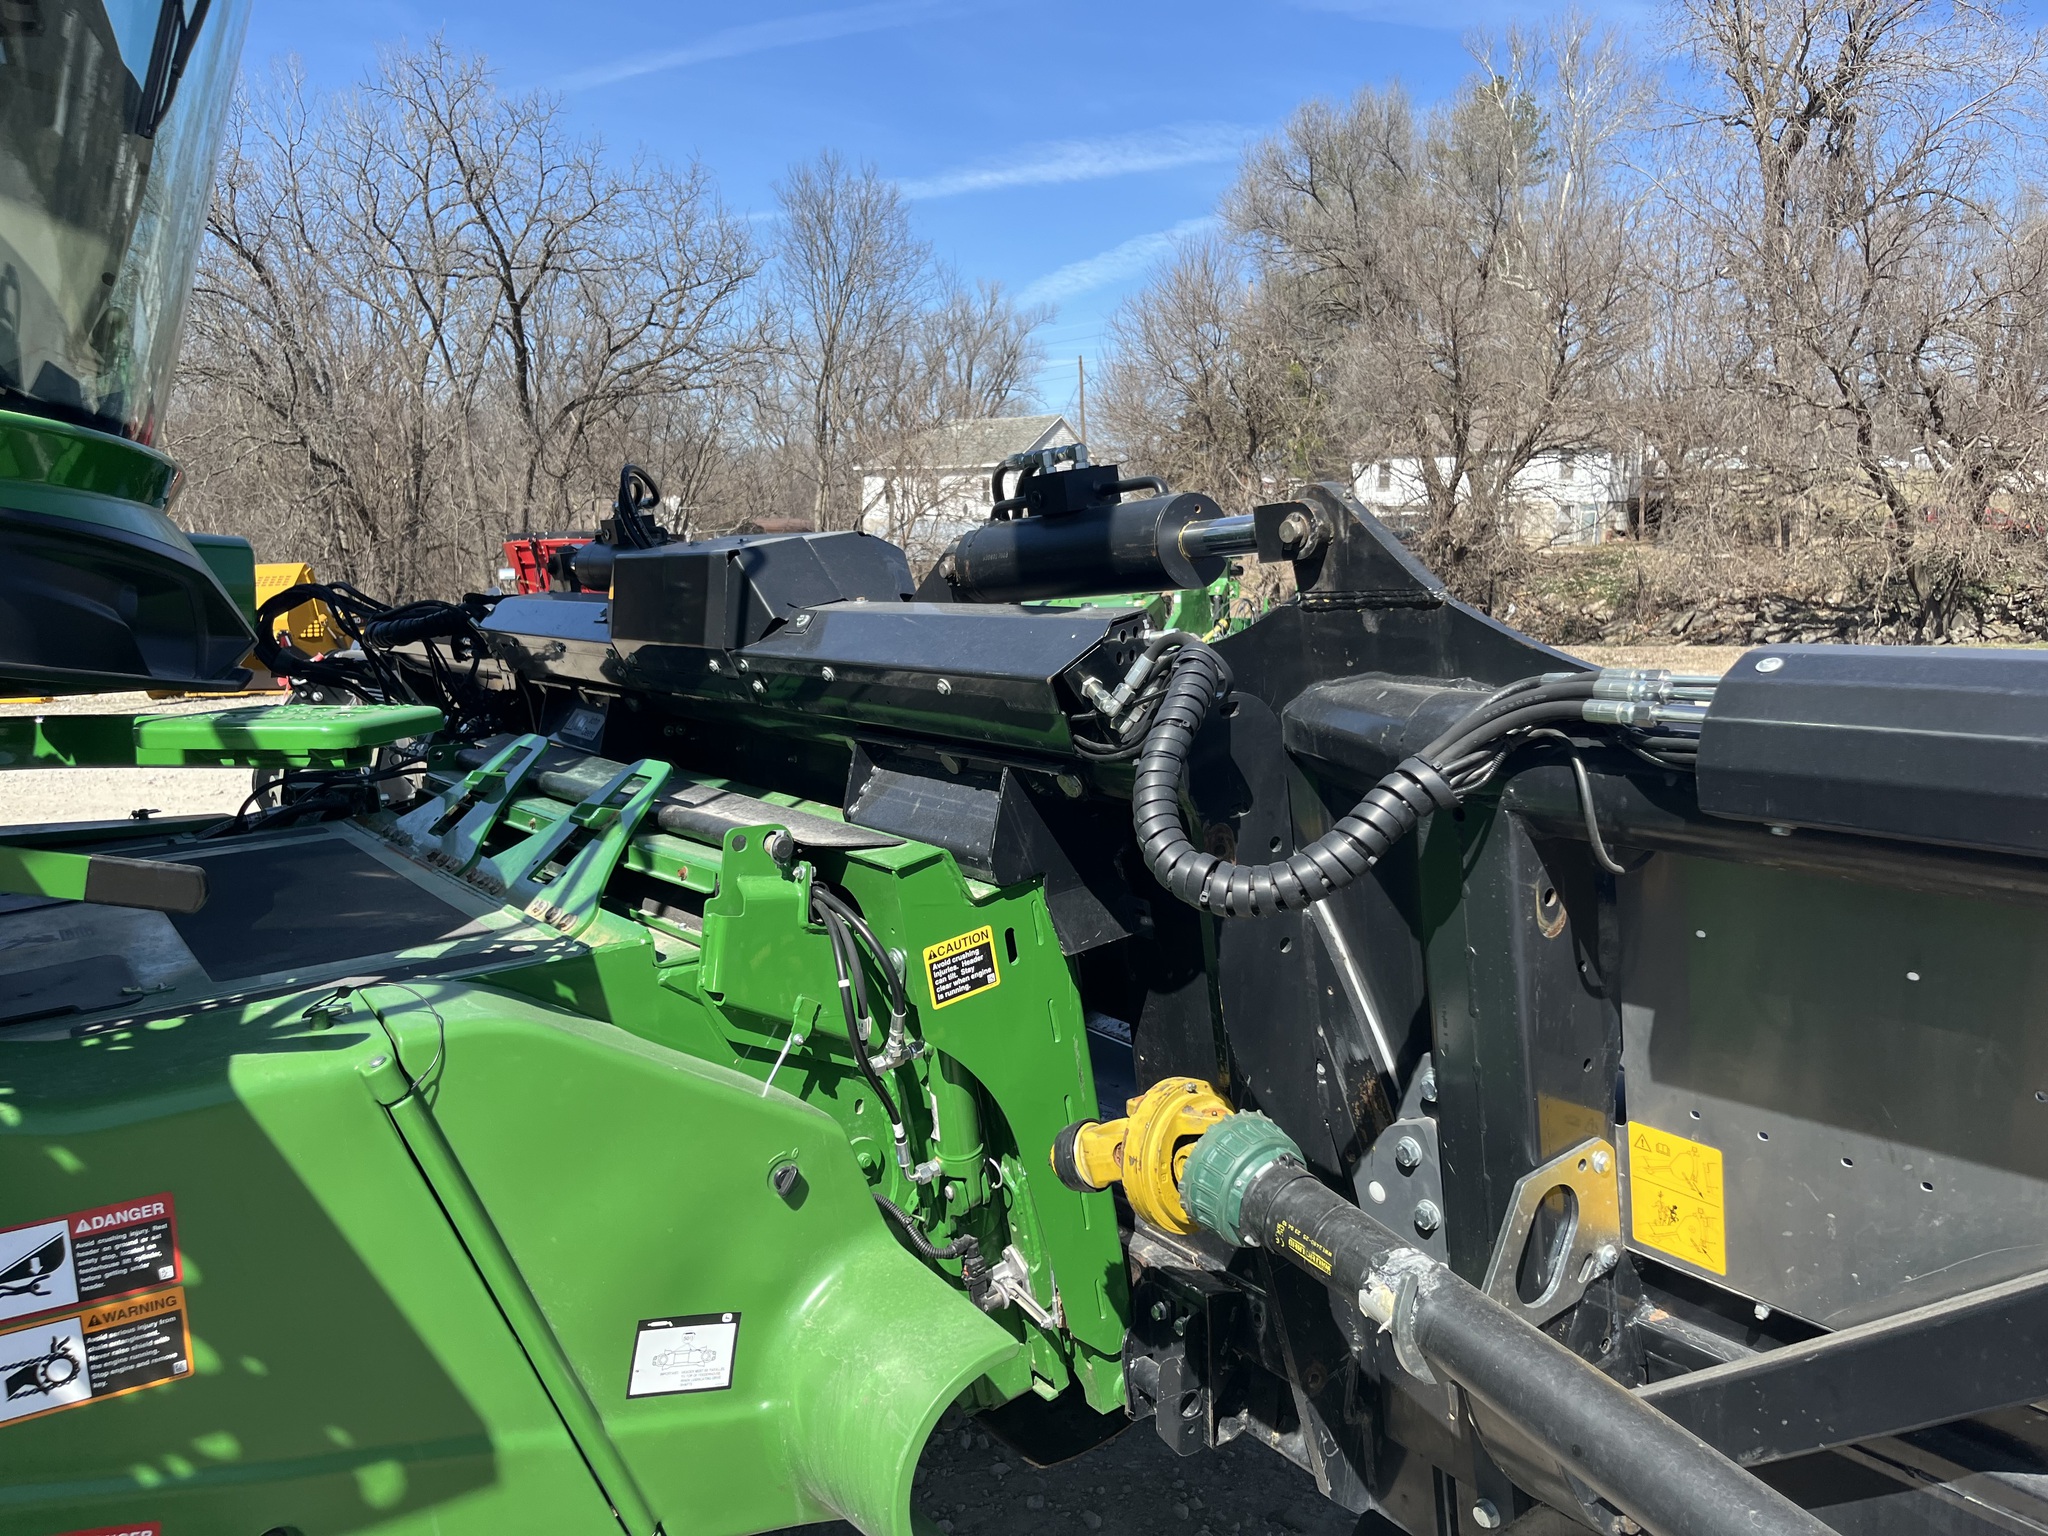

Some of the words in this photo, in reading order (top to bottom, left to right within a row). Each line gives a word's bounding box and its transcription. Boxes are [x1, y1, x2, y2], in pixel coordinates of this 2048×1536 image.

[937, 930, 988, 956] CAUTION
[932, 959, 951, 970] Avoid
[952, 949, 980, 963] crushing
[962, 955, 983, 967] Header
[936, 983, 951, 992] clear
[953, 976, 970, 986] when
[971, 968, 991, 979] engine
[948, 972, 958, 981] tilt.
[961, 966, 975, 975] Stay
[945, 984, 971, 997] running.
[91, 1202, 164, 1229] DANGER
[75, 1240, 94, 1248] Avoid
[97, 1233, 127, 1244] crushing
[129, 1228, 150, 1237] injury.
[76, 1248, 99, 1257] header
[114, 1239, 138, 1250] ground
[77, 1258, 98, 1267] safety
[120, 1246, 144, 1256] located
[78, 1261, 120, 1274] feederhouse
[80, 1274, 101, 1283] before
[104, 1268, 127, 1278] getting
[130, 1263, 150, 1271] under
[80, 1282, 106, 1291] header.
[103, 1295, 177, 1323] WARNING
[86, 1333, 108, 1344] Avoid
[108, 1327, 135, 1338] serious
[137, 1321, 158, 1332] injury
[159, 1316, 176, 1324] from
[87, 1343, 108, 1352] chain
[108, 1329, 160, 1348] entanglement.
[89, 1351, 110, 1361] Never
[111, 1346, 129, 1355] raise
[131, 1340, 153, 1350] shield
[154, 1335, 170, 1344] with
[91, 1370, 109, 1380] Stop
[110, 1364, 134, 1375] engine
[135, 1360, 149, 1368] and
[151, 1353, 178, 1363] remove
[103, 1356, 128, 1368] engine
[129, 1348, 160, 1361] running.
[93, 1380, 108, 1389] key.
